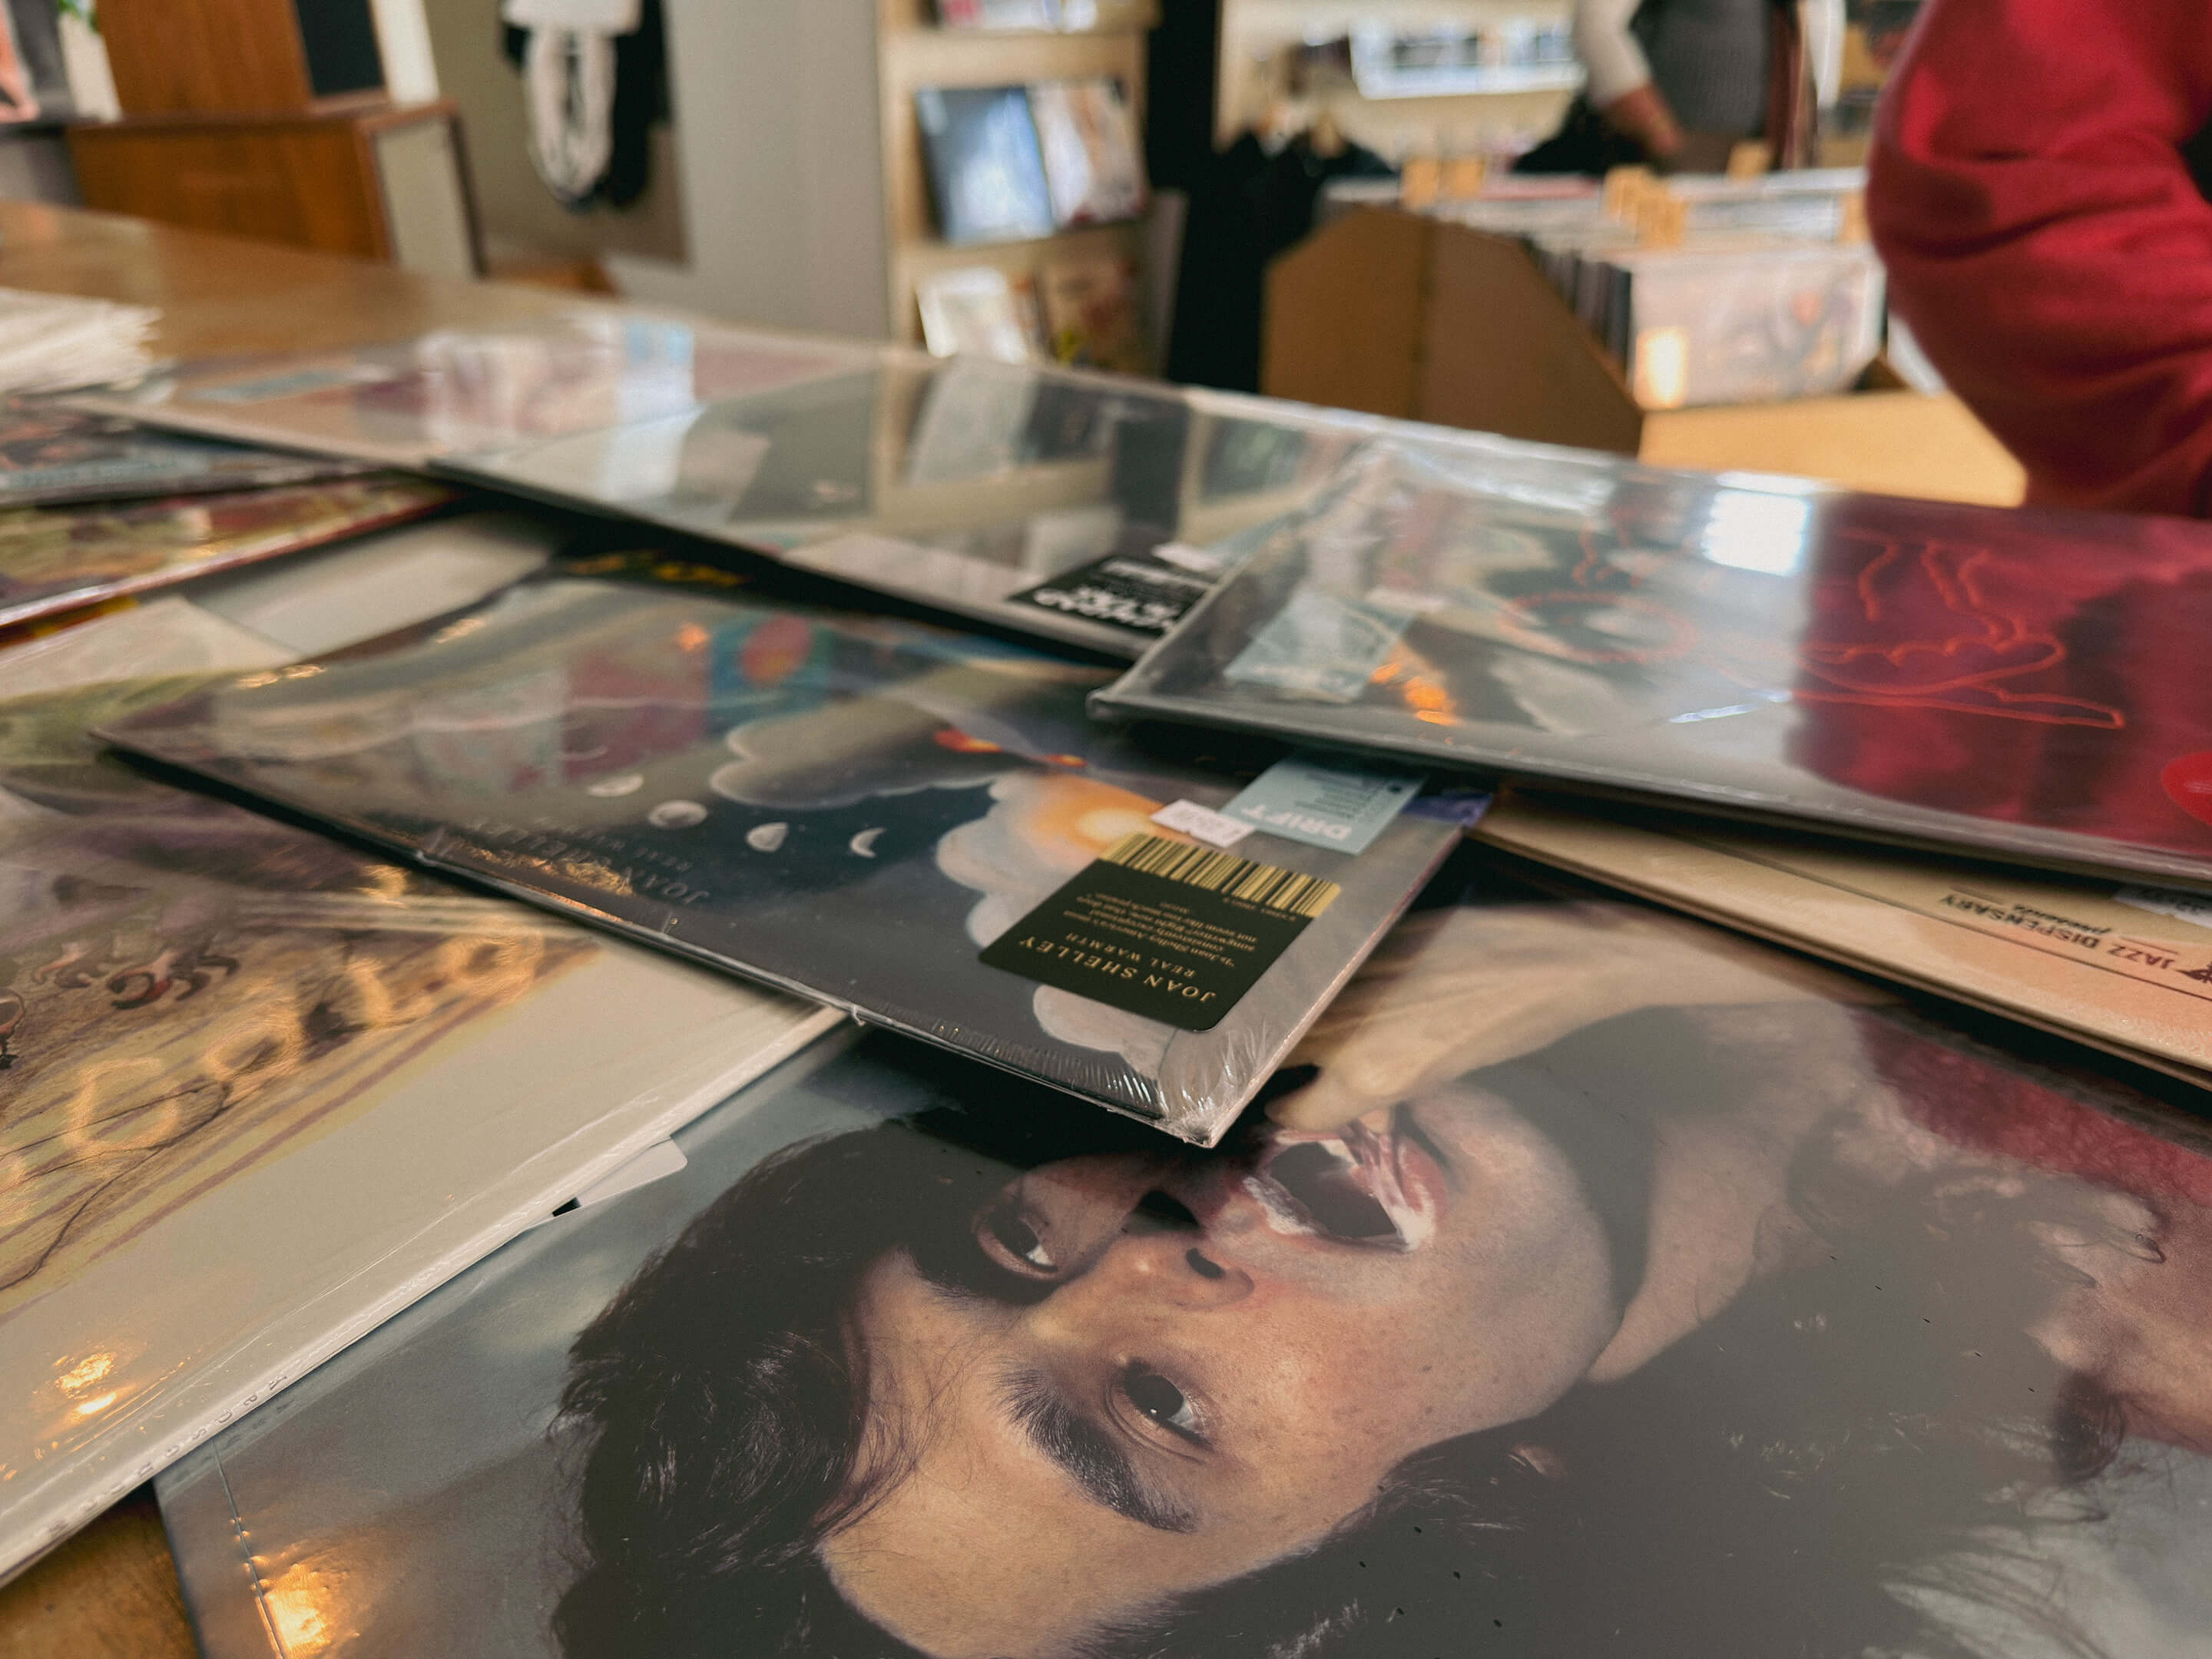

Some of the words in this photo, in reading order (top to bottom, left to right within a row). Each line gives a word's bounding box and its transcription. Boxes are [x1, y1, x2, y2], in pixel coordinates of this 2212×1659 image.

[1241, 804, 1353, 841] DRIFT
[1939, 893, 2101, 949] DISPENSARY
[1019, 936, 1137, 978] SHELLEY
[1065, 933, 1141, 962] WARMTH
[1190, 948, 1220, 961] Joan
[2107, 942, 2176, 970] JAZZ
[1151, 959, 1195, 978] REAL
[1143, 974, 1216, 1002] JOAN
